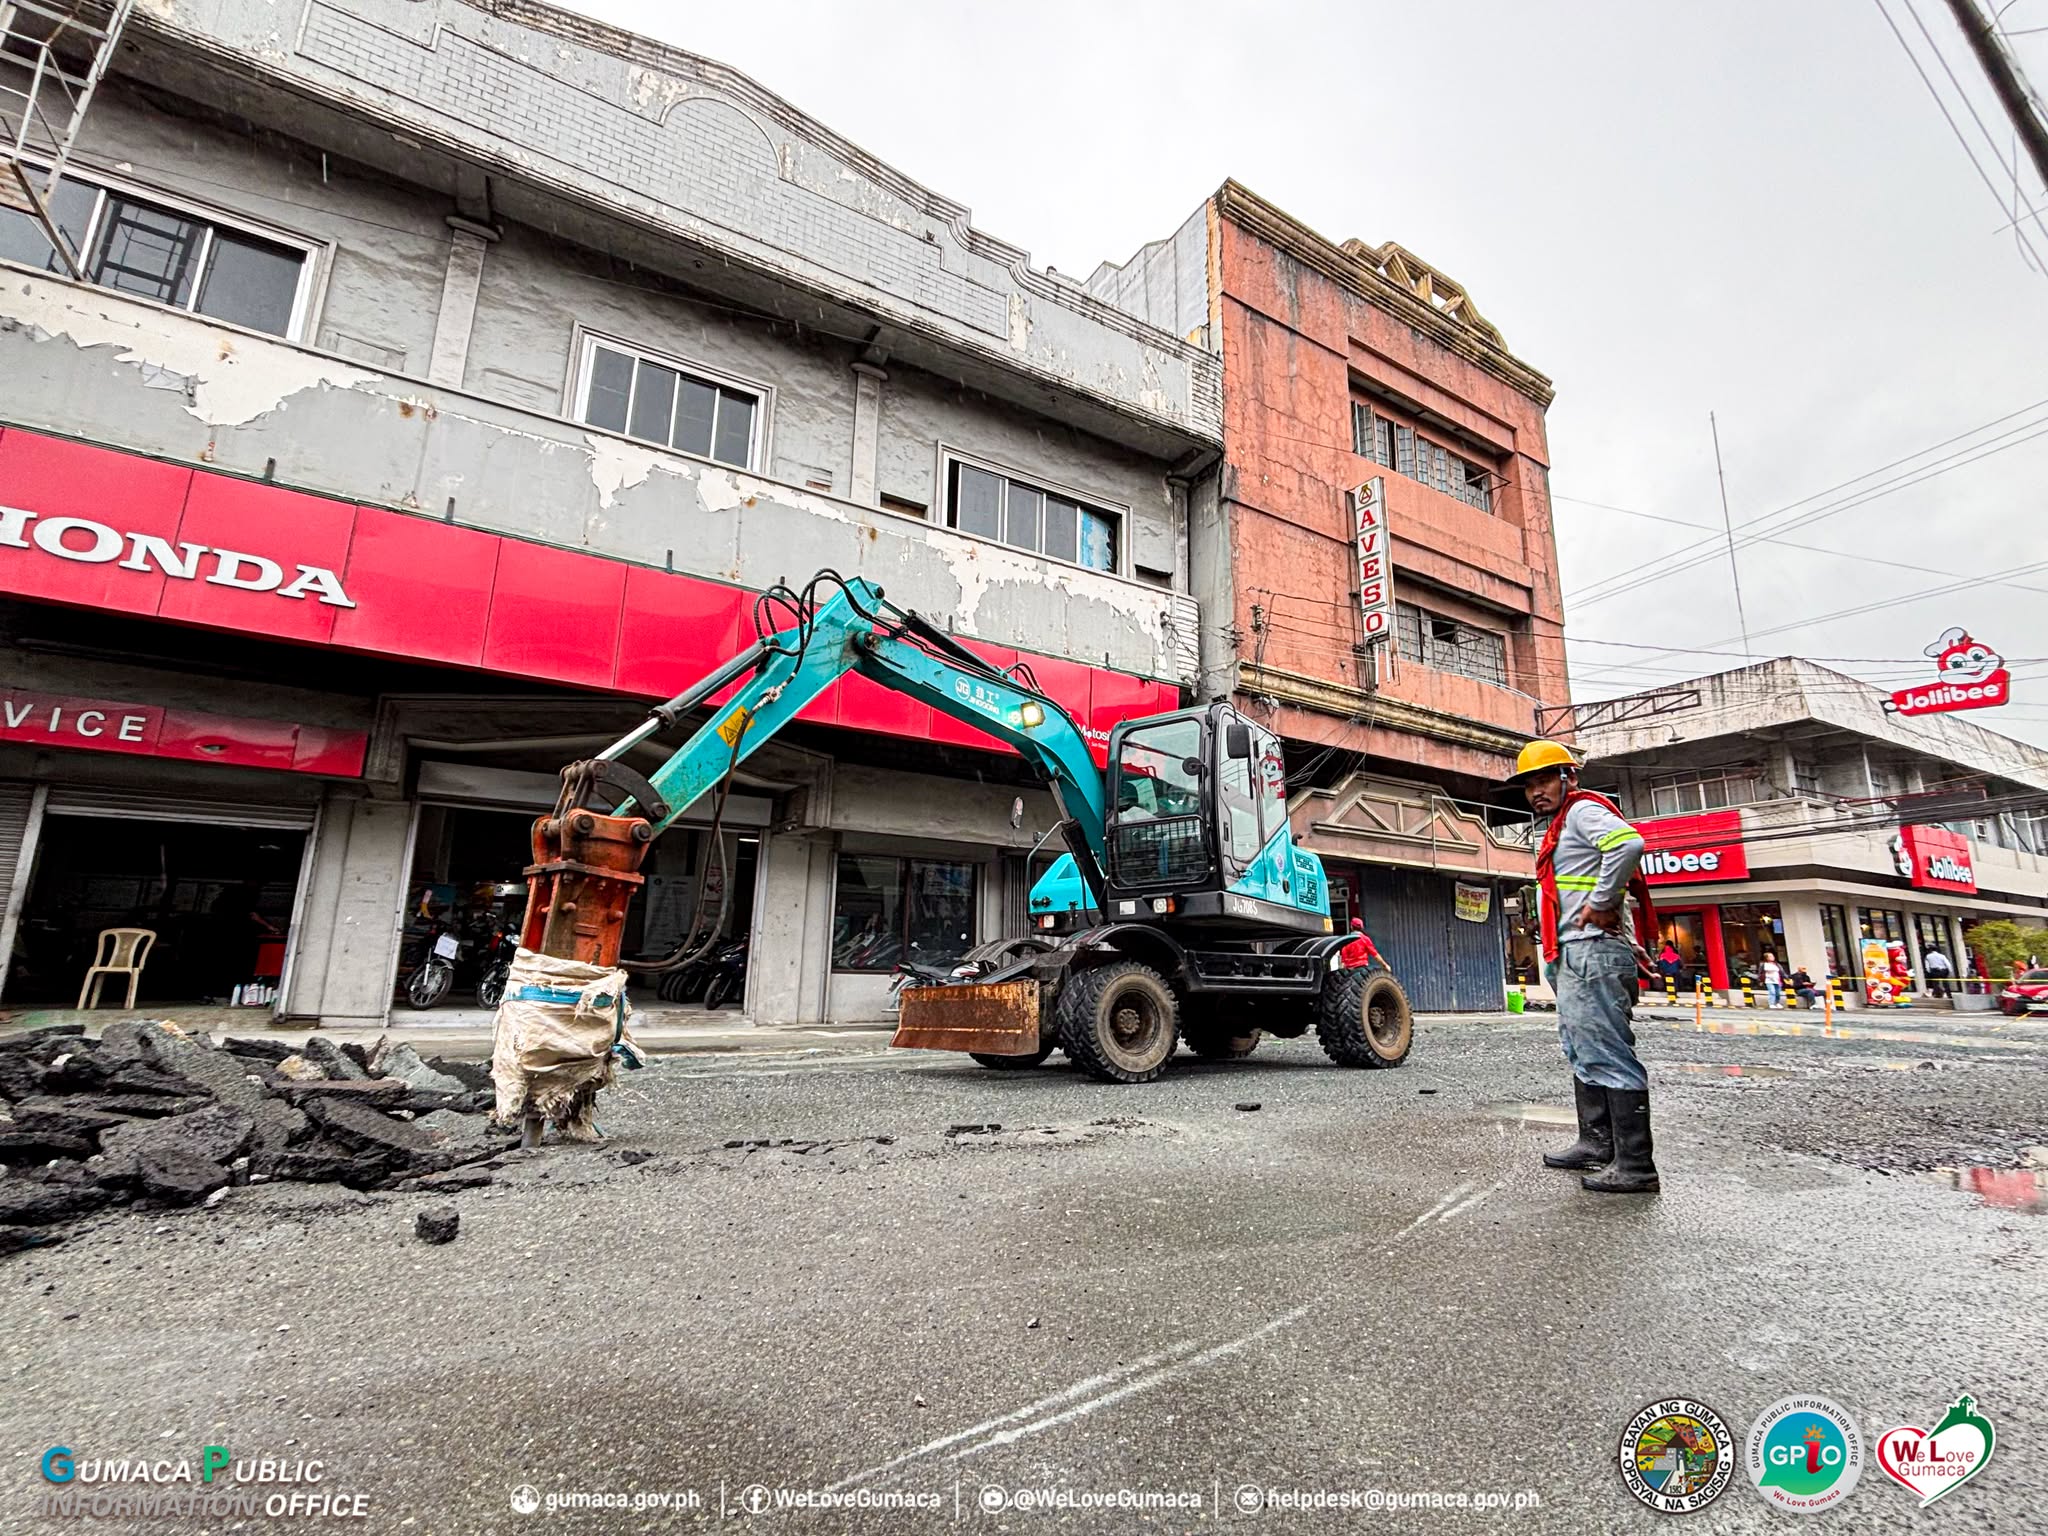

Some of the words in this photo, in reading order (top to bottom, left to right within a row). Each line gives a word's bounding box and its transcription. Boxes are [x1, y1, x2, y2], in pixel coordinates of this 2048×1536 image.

[1360, 509, 1383, 633] AVESO
[1898, 684, 1999, 710] Jollibee
[1926, 855, 1973, 883] Jollibee
